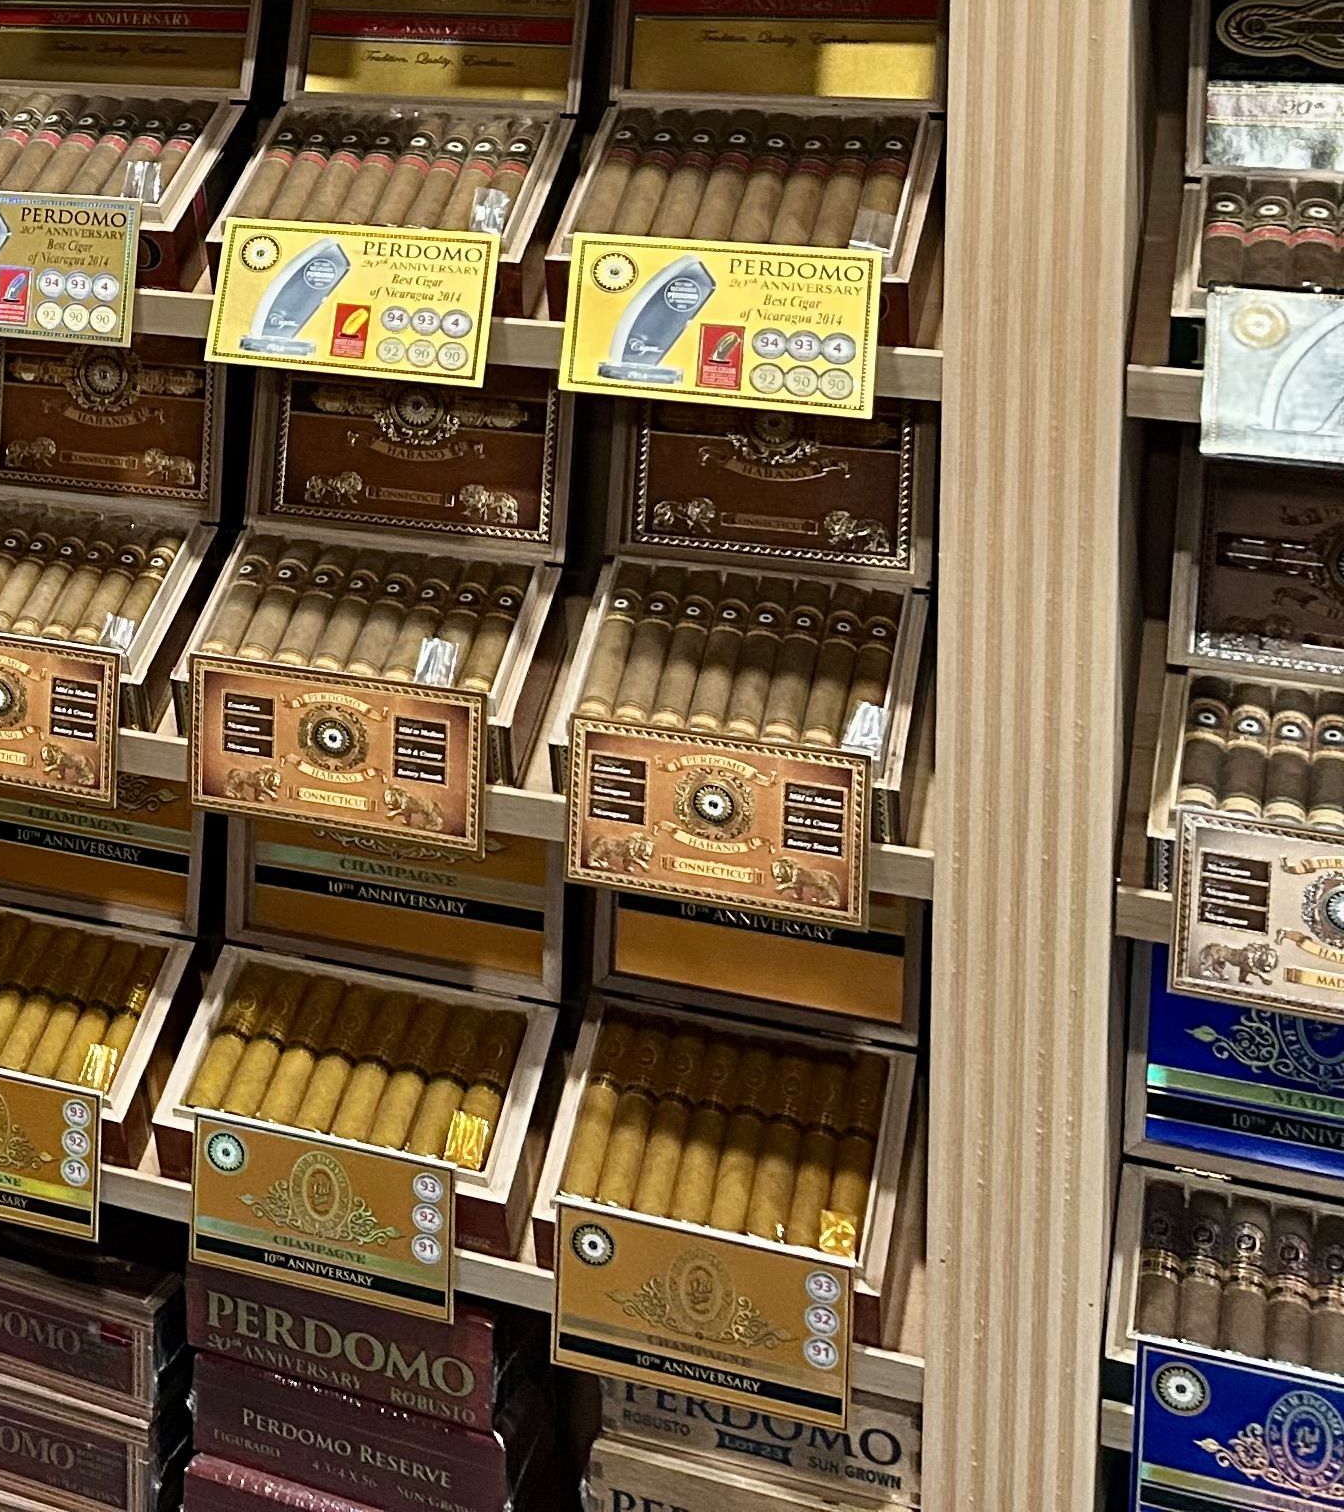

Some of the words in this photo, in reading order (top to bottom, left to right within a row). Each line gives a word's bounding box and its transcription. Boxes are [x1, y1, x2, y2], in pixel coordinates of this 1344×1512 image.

[86, 10, 192, 27] ANNIVERSARY
[20, 206, 128, 228] PERDOMO
[48, 227, 126, 241] ANNIVERSARY
[41, 252, 85, 268] Nicaragua
[362, 240, 484, 263] PERDOMO
[390, 260, 481, 277] ANNIVERSARY
[729, 257, 864, 282] PERDOMO
[44, 276, 60, 289] 94
[71, 278, 87, 291] 93
[760, 280, 863, 297] ANNIVERSARY
[384, 286, 433, 303] Nicaragua
[386, 311, 404, 324] 94
[416, 314, 435, 327] 93
[754, 308, 813, 324] Nicaragua
[760, 337, 779, 349] 94
[794, 339, 813, 351] 93
[306, 692, 364, 711] PERDOMO
[684, 755, 747, 773] PERDOMO
[310, 767, 361, 784] HABANO
[295, 787, 370, 810] CONNECTICUT
[42, 831, 142, 864] ANNIVERSARY
[688, 837, 741, 853] HABANO
[672, 859, 753, 882] CONNECTICUT
[358, 884, 468, 916] ANNIVERSARY
[69, 1106, 86, 1120] 93
[68, 1134, 86, 1149] 92
[67, 1164, 84, 1179] 91
[420, 1180, 437, 1194] 93
[419, 1210, 436, 1226] 92
[418, 1240, 435, 1256] 91
[288, 1256, 374, 1288] ANNIVERSARY
[813, 1277, 834, 1294] 93
[812, 1312, 831, 1328] 92
[207, 1290, 476, 1398] PERDOMO
[811, 1344, 831, 1362] 91
[663, 1359, 761, 1395] ANNIVERSARY
[390, 1387, 477, 1425] ROBUSTO
[623, 1409, 690, 1436] ROBUSTO
[241, 1405, 353, 1458] PERDOMO
[807, 1456, 840, 1475] SUN
[845, 1464, 902, 1490] GROWN
